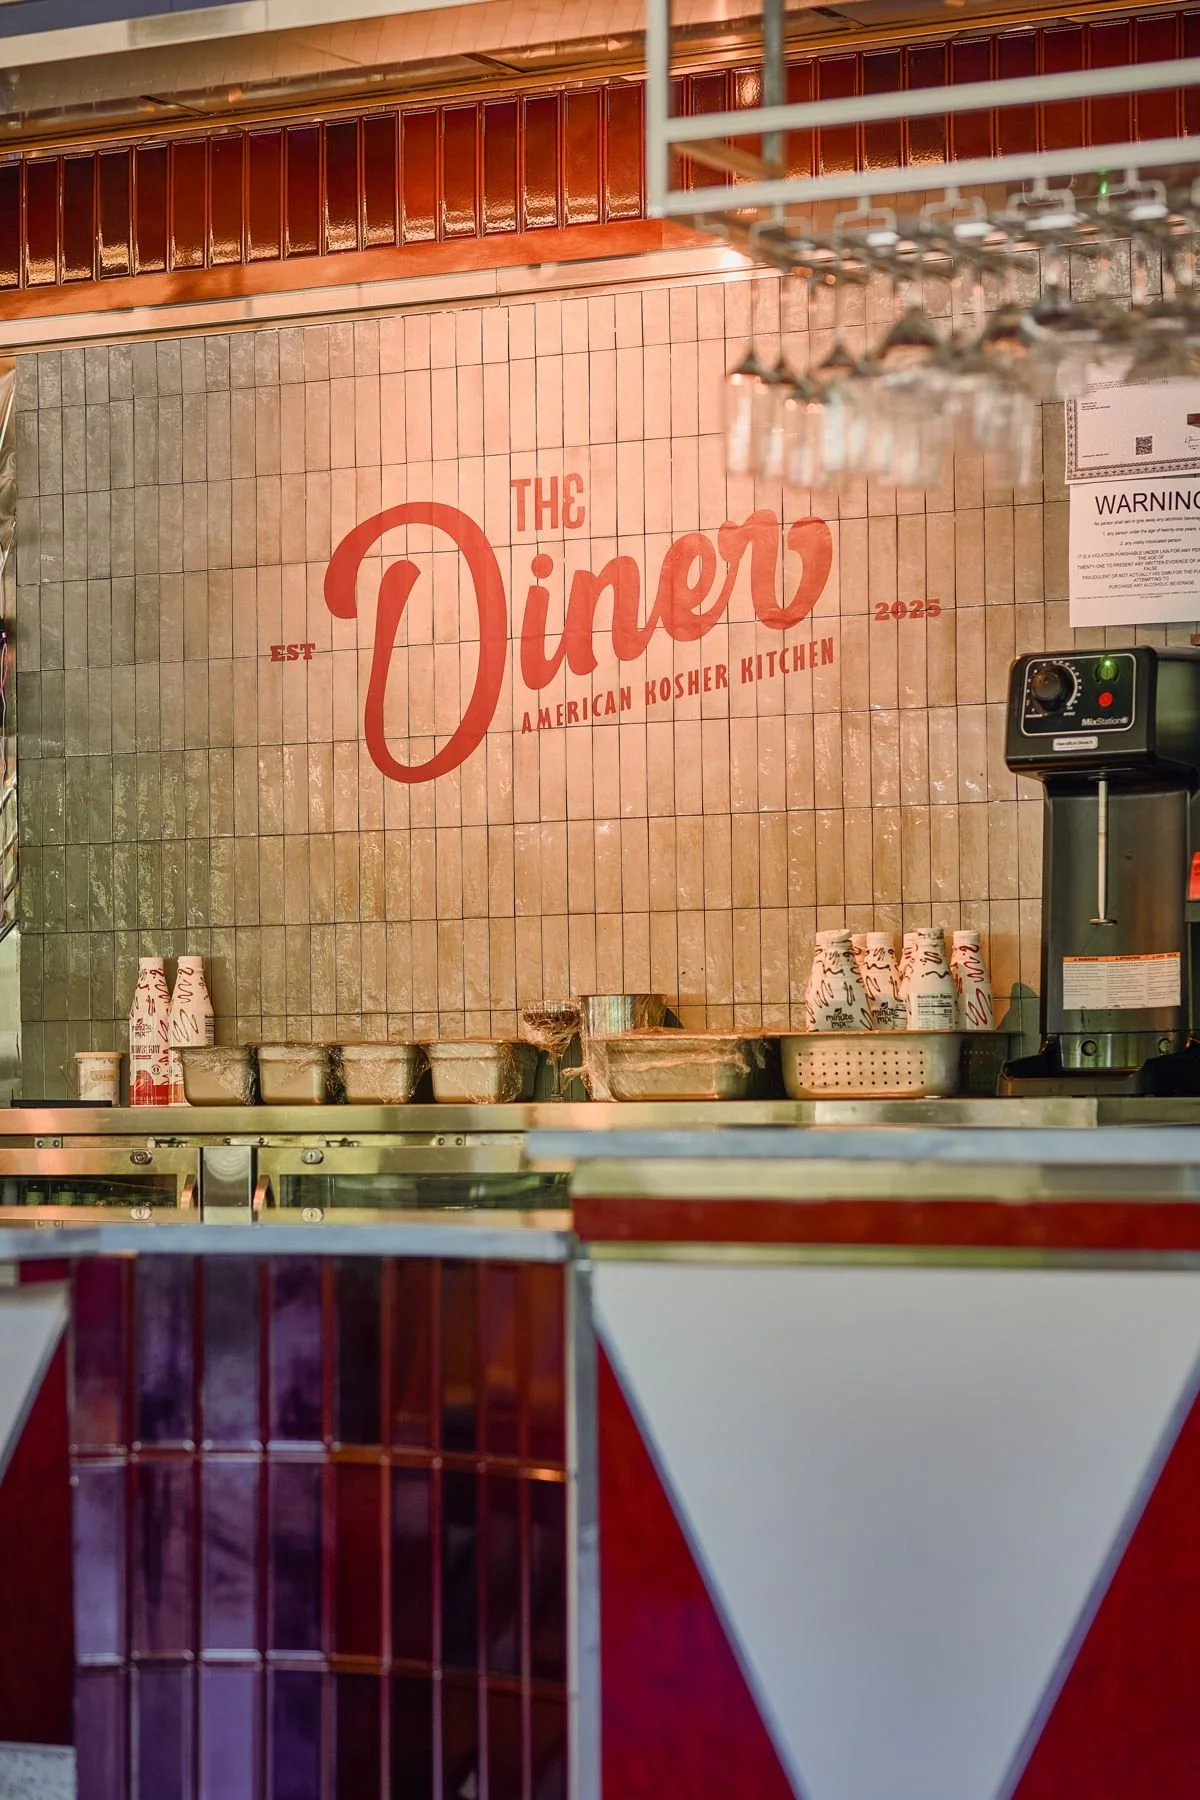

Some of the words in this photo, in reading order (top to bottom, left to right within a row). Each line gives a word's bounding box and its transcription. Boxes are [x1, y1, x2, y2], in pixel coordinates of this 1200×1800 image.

[510, 471, 586, 532] THE
[875, 598, 942, 621] 2025
[323, 501, 834, 784] Diner
[270, 643, 316, 662] EST
[521, 685, 632, 735] AMERICAN
[645, 663, 729, 706] KOSHER
[740, 637, 835, 684] KITCHEN
[826, 1012, 854, 1022] minute
[872, 1008, 898, 1018] minute
[877, 1016, 892, 1024] mix
[831, 1020, 848, 1029] mix
